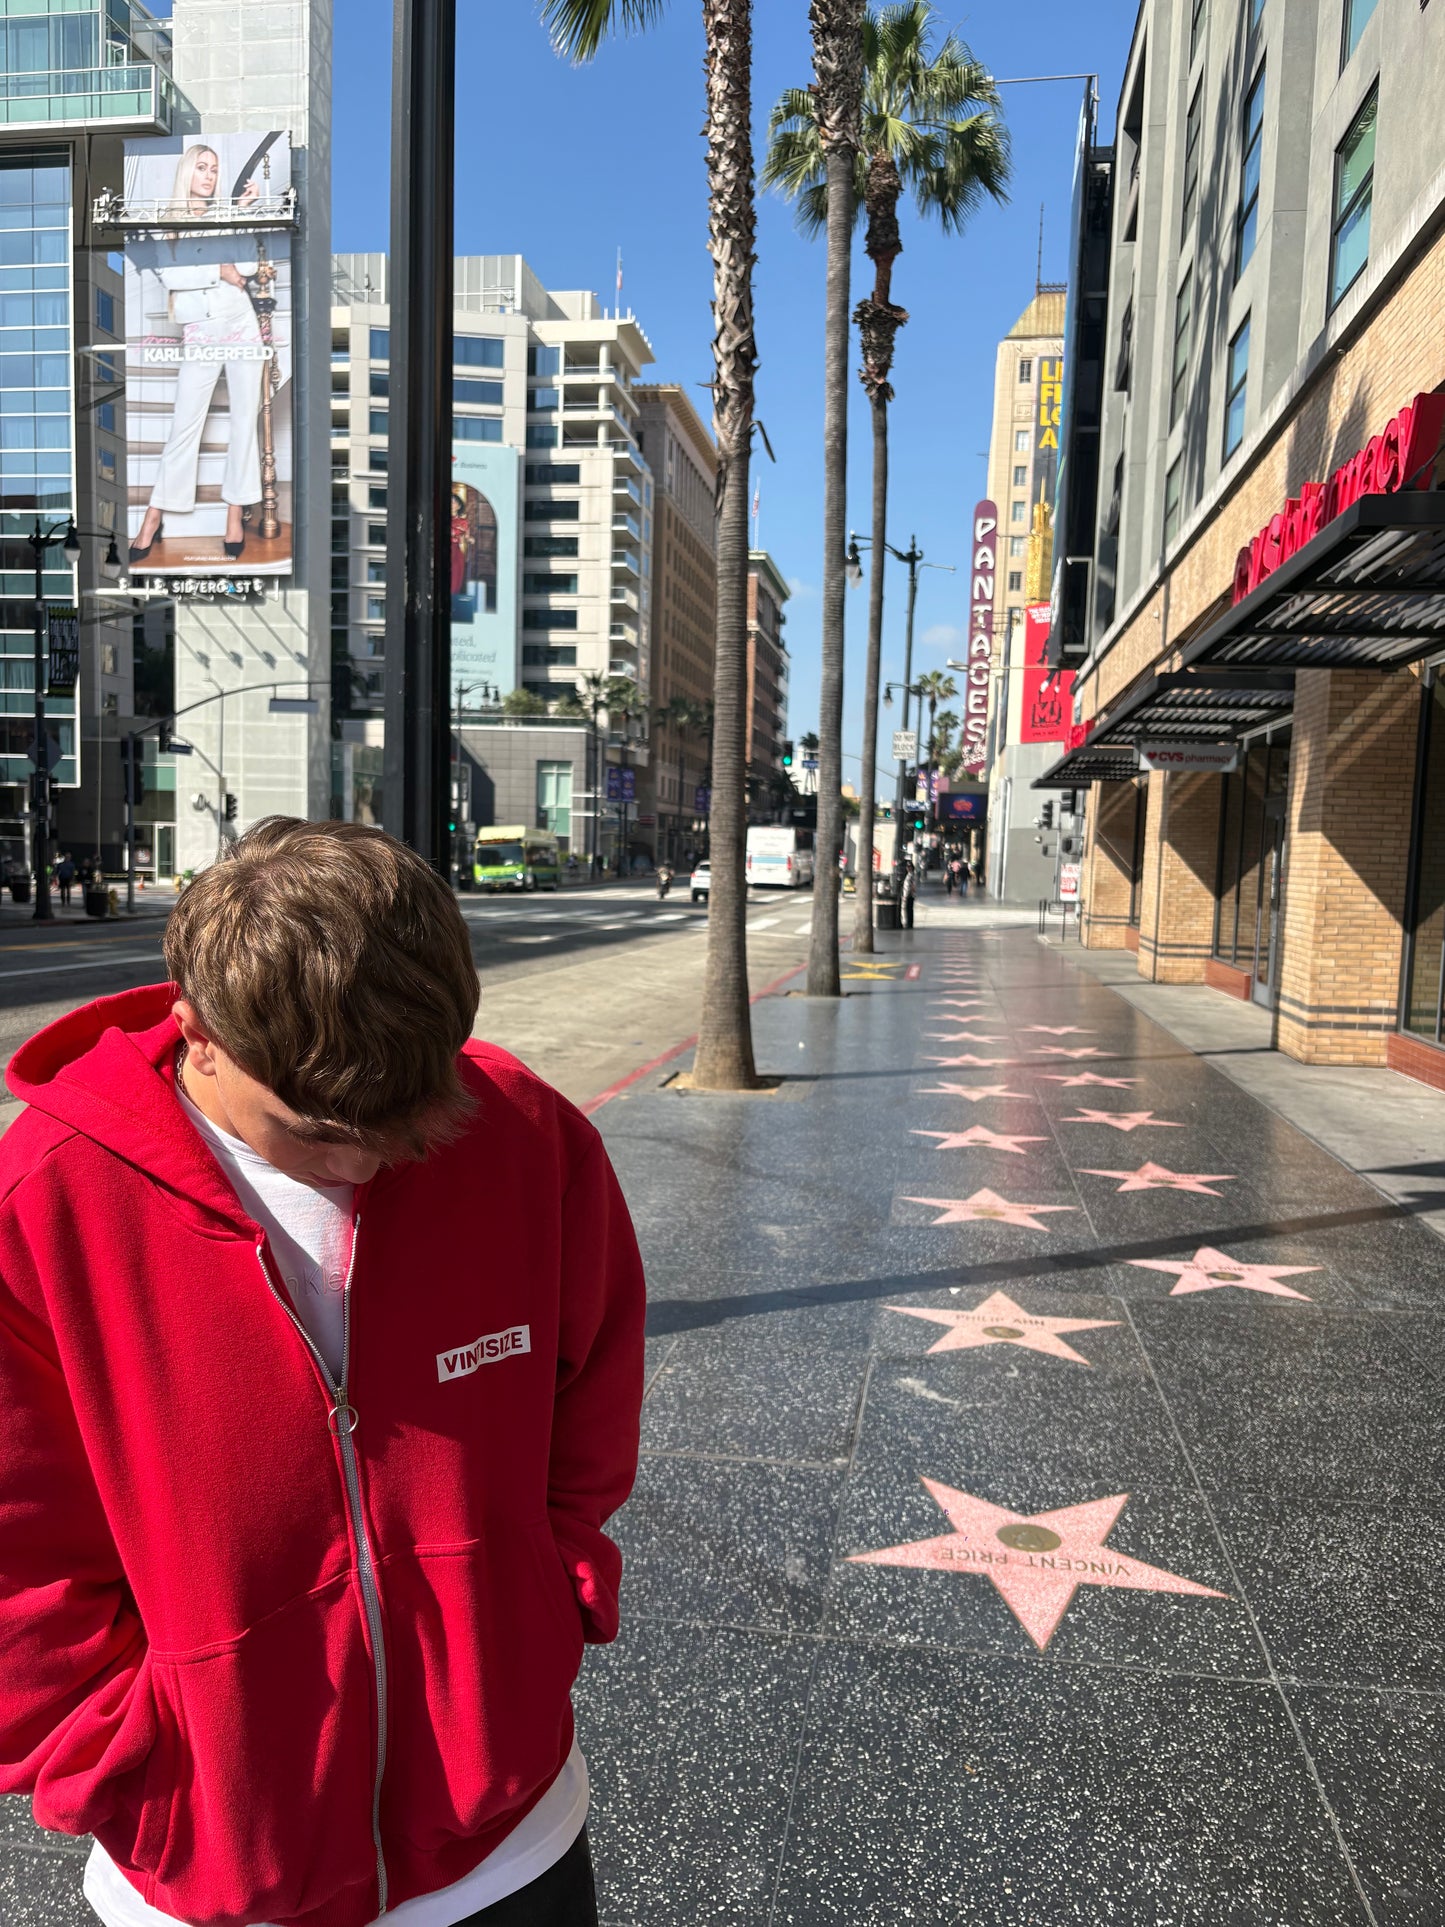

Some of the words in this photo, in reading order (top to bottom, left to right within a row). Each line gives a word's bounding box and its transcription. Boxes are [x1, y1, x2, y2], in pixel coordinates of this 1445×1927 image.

[144, 348, 184, 362] KARL
[184, 346, 274, 361] LAGERFELD
[967, 517, 997, 742] PANTAGES
[1159, 751, 1184, 762] CVS
[1185, 753, 1232, 764] pharmacy
[940, 1547, 1008, 1565] PRICE
[1025, 1556, 1132, 1577] VINCENT
